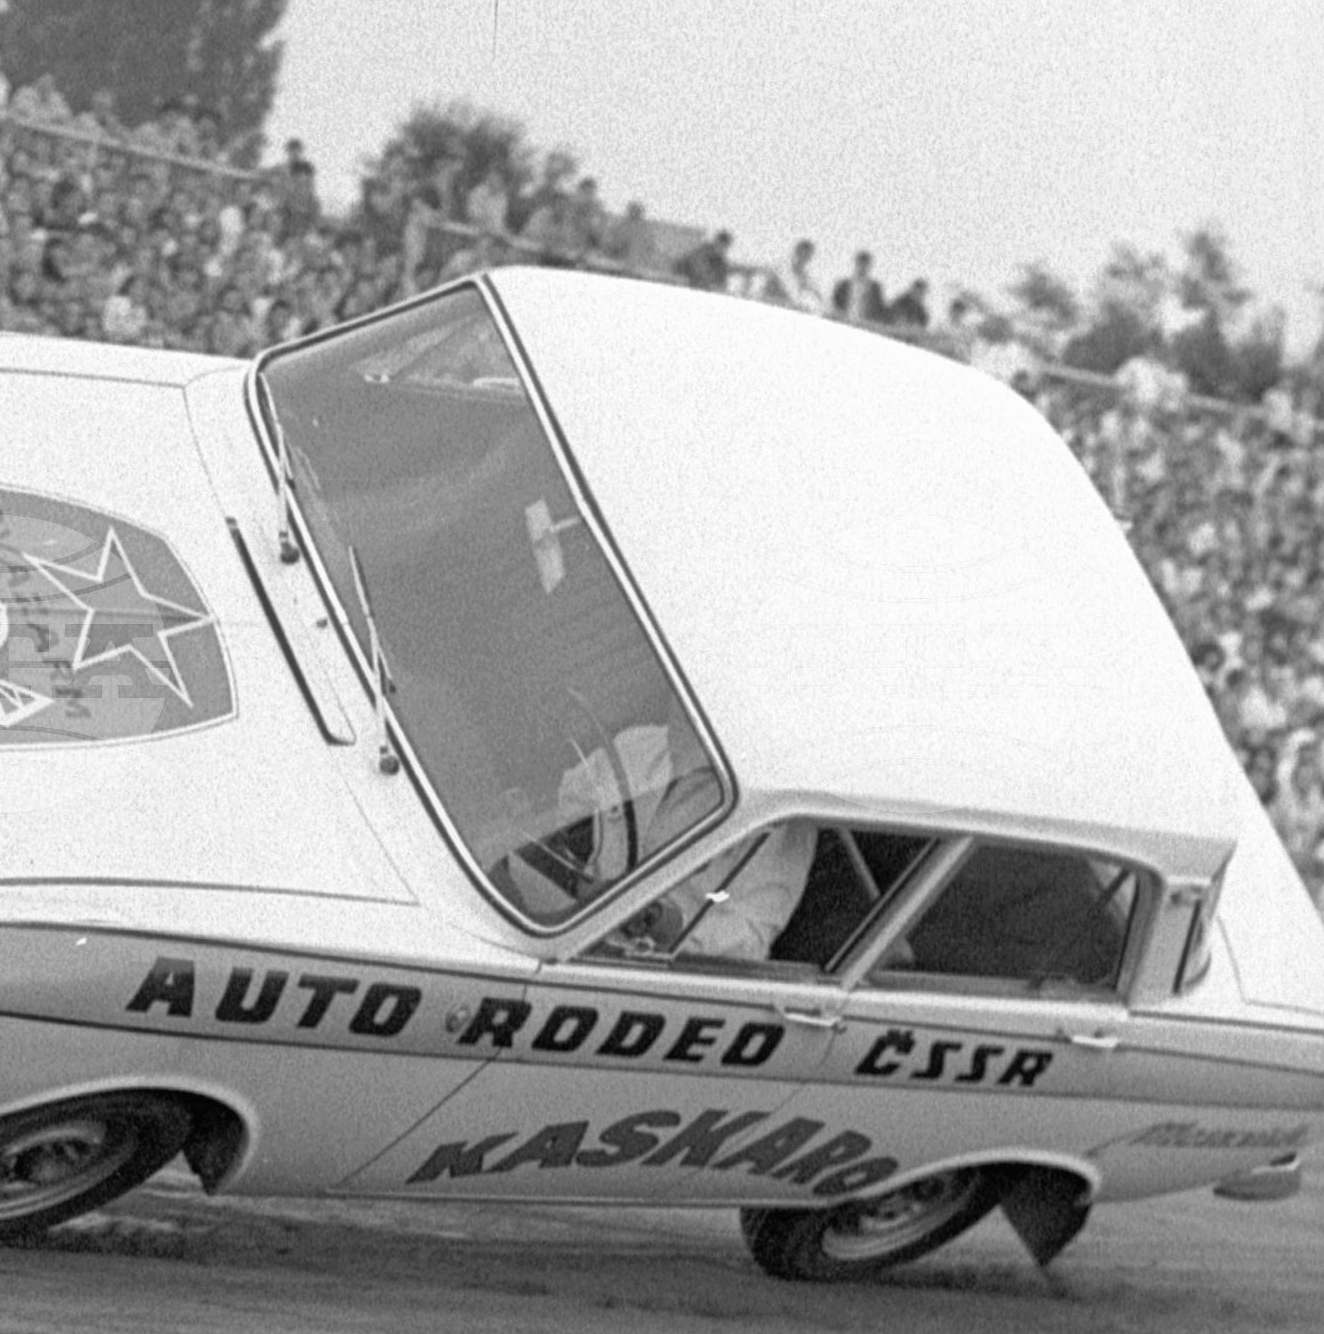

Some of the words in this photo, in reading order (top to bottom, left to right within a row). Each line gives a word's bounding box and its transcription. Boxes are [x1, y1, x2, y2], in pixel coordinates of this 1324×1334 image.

[125, 956, 423, 1037] AUTO
[457, 996, 785, 1068] RODEO
[853, 1029, 1053, 1087] ČSSR
[404, 1109, 899, 1195] KASKARO
